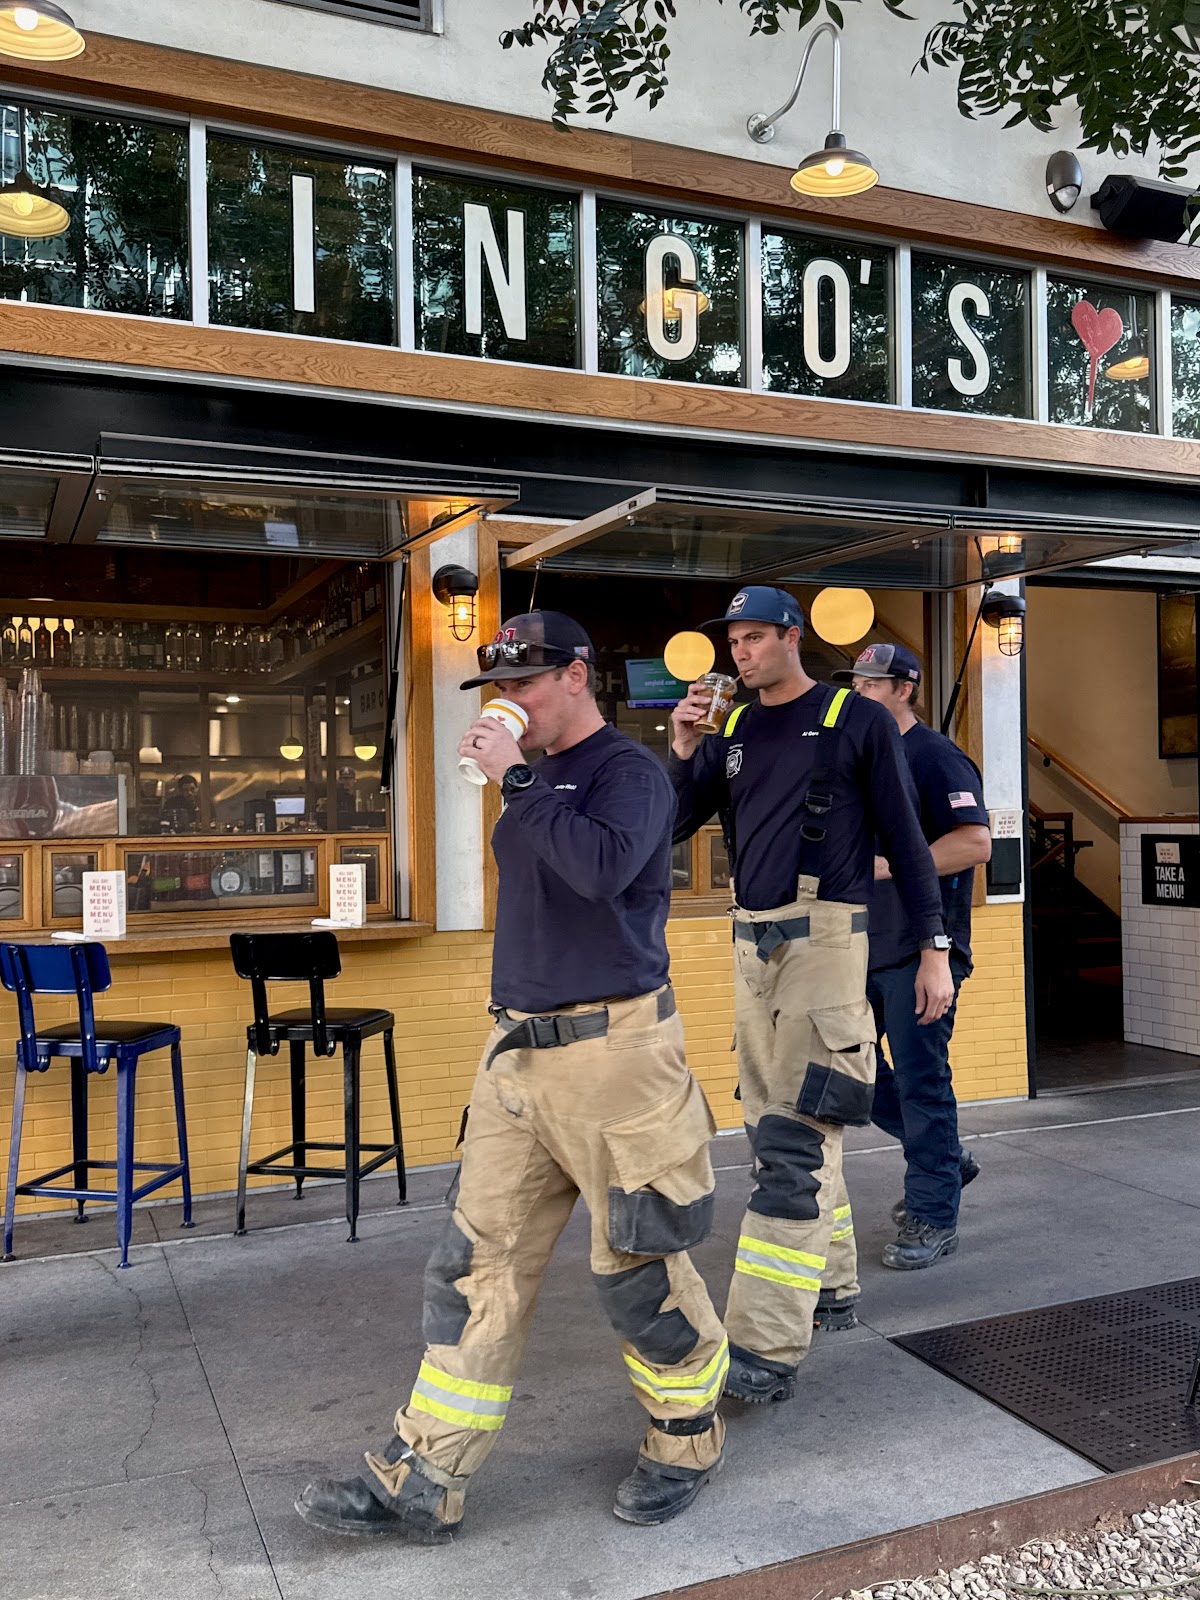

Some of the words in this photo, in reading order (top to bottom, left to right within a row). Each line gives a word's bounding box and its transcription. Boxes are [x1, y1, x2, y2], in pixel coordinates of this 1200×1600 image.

[291, 173, 991, 396] INGO'S
[856, 647, 877, 663] 21
[1155, 866, 1177, 881] TAKE
[1178, 866, 1185, 882] A
[1156, 884, 1184, 899] MENU!
